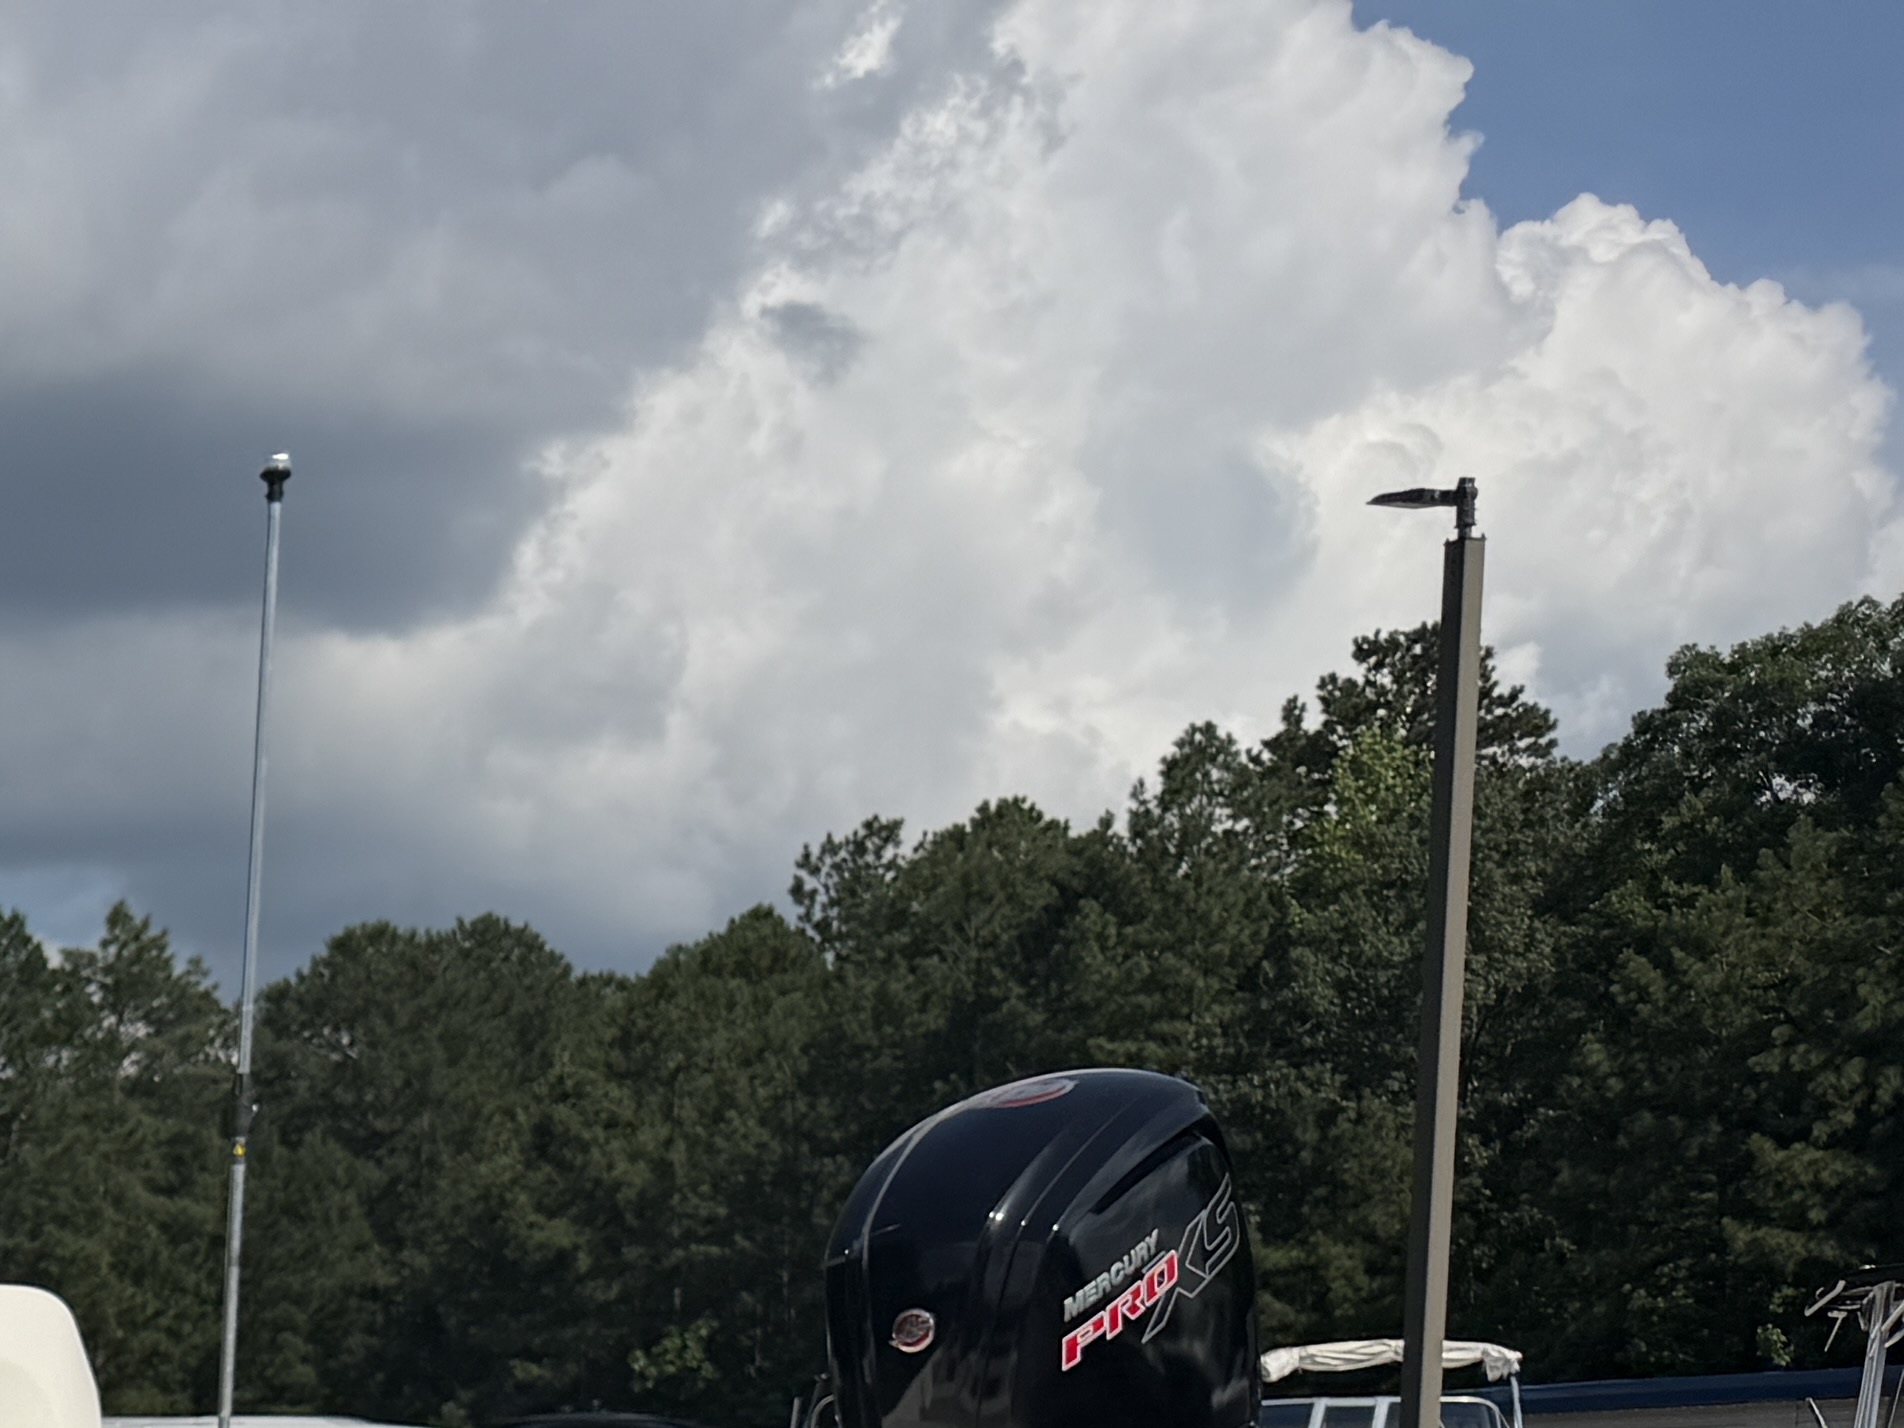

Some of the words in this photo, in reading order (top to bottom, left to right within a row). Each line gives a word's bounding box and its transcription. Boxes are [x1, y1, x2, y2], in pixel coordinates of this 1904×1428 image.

[1061, 1249, 1178, 1371] PRO
[1141, 1172, 1240, 1344] XS
[1063, 1228, 1159, 1322] MERCURY
